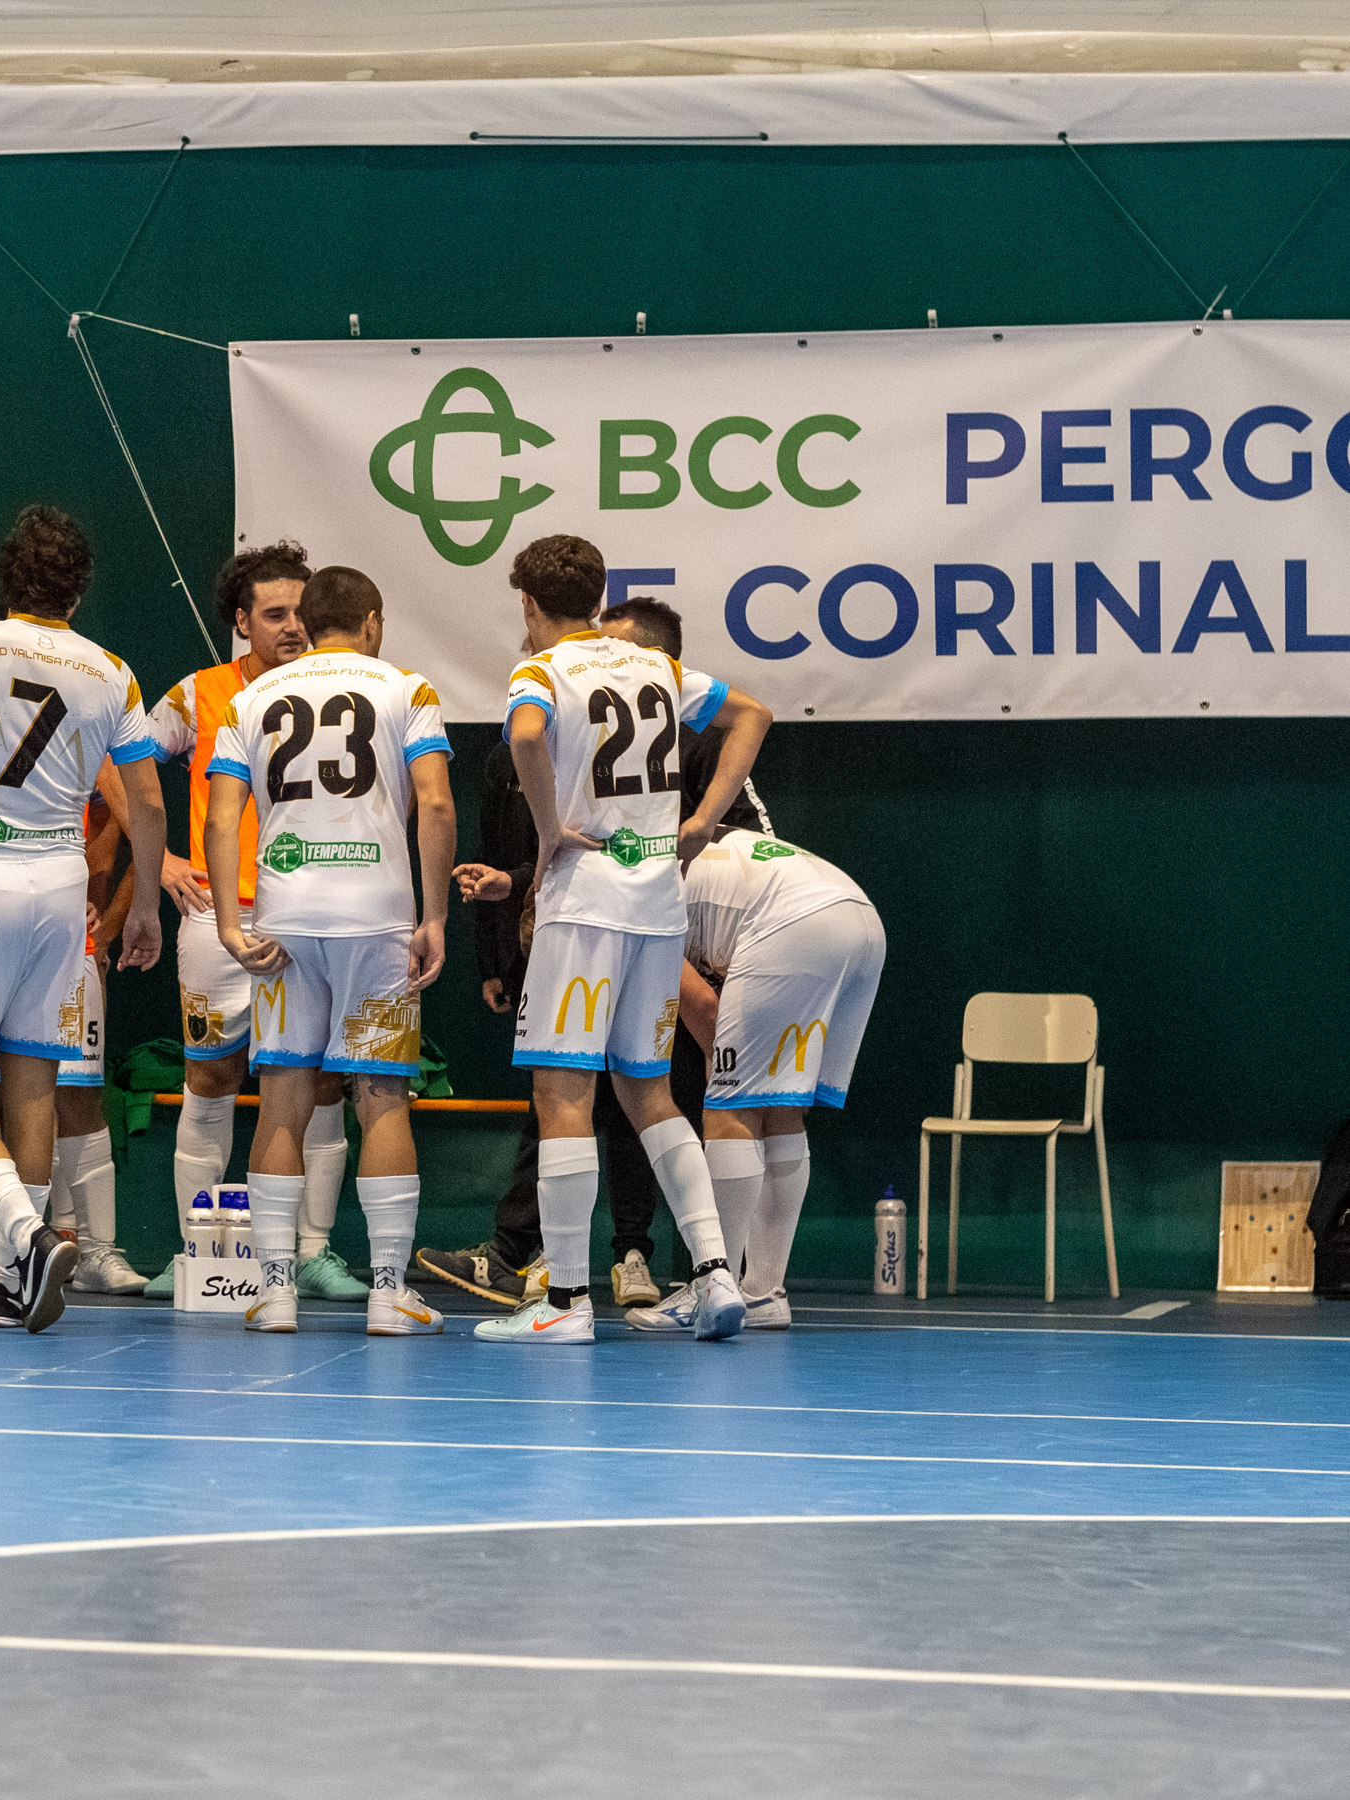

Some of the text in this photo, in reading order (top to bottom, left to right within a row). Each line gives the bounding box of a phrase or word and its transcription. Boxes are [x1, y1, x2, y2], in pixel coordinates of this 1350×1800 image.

[598, 413, 861, 511] BCC
[946, 405, 1350, 506] PERG
[725, 559, 1350, 661] CORINAL
[10, 646, 62, 666] VALMISA
[64, 659, 108, 683] FUTSAL
[256, 668, 388, 693] ASD VALMISA FUTSAL
[566, 663, 588, 676] ASD
[262, 691, 378, 807] 23
[588, 681, 681, 799] 22
[306, 843, 378, 861] TEMPOCASA
[714, 1046, 737, 1073] 10
[882, 1230, 900, 1286] Sixtus
[201, 1275, 260, 1301] Sixtu
